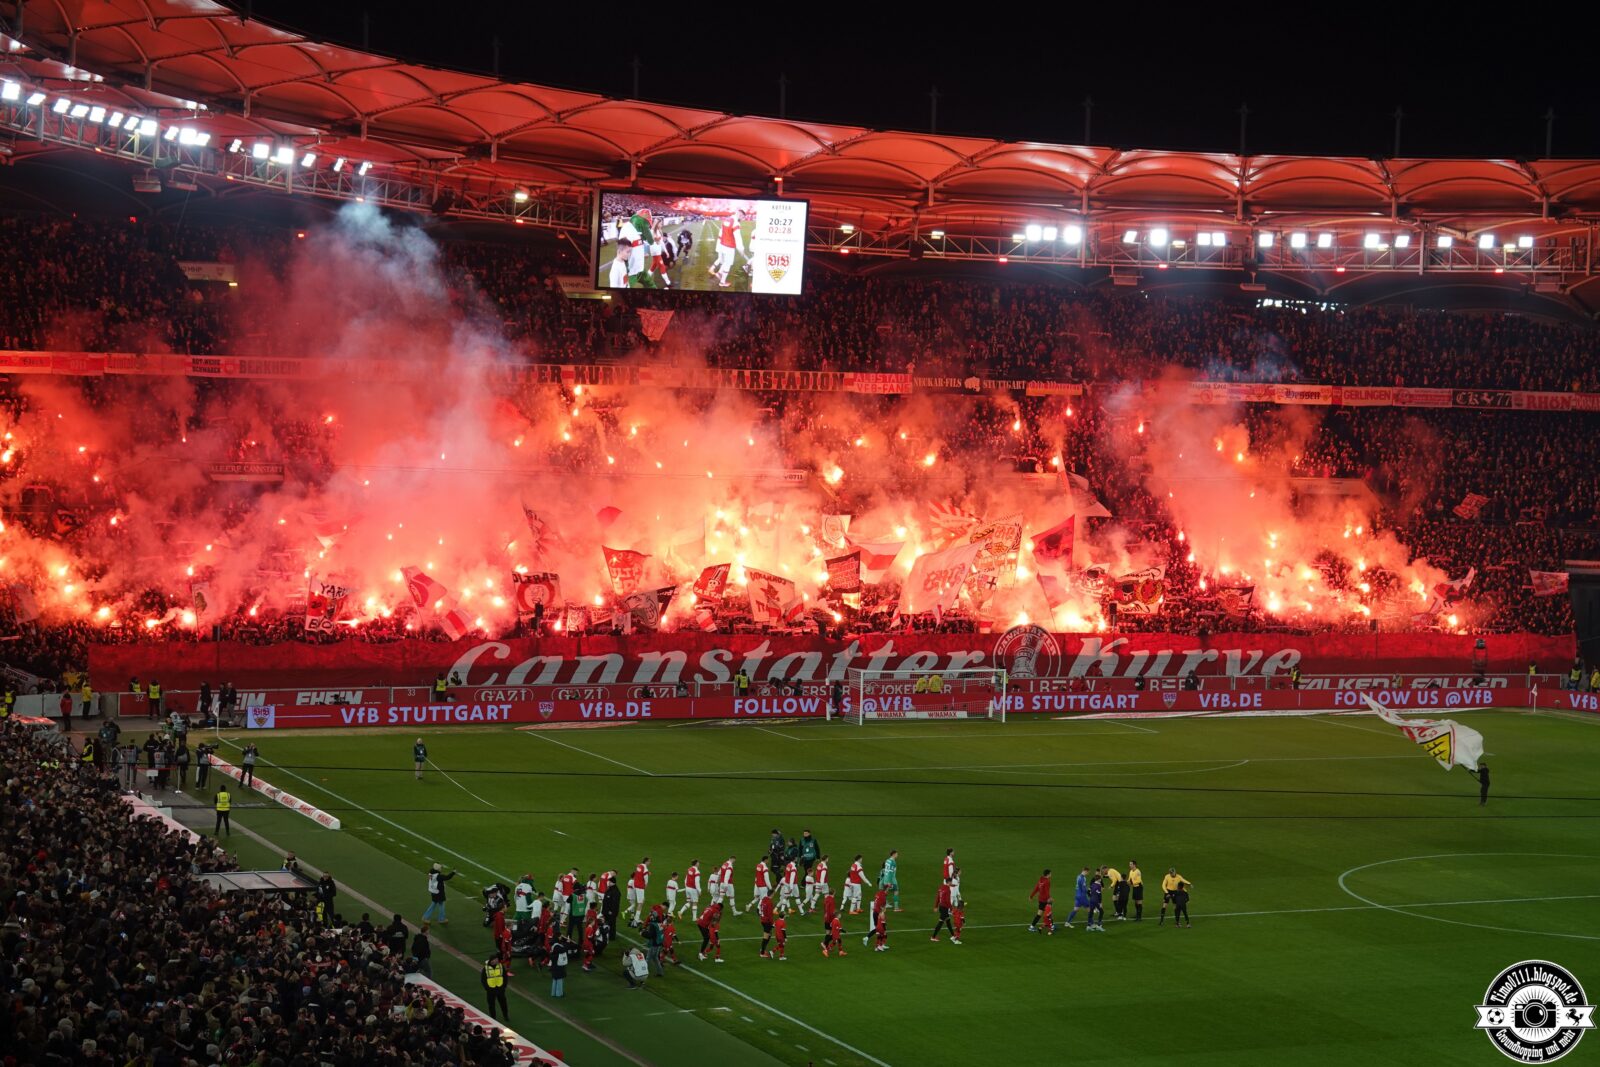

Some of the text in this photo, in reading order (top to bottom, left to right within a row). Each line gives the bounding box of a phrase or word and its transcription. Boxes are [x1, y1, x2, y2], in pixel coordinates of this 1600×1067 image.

[769, 217, 793, 226] 20:27
[768, 226, 792, 234] 02:28
[1343, 390, 1391, 401] GERLINGEN
[450, 636, 1301, 686] Cannstatter Kurve
[407, 688, 416, 697] 33
[1199, 692, 1263, 708] VfB.DE
[1417, 690, 1439, 705] US
[1445, 690, 1493, 706] @VfB
[579, 701, 652, 718] VfB.DE
[734, 697, 820, 714] FOLLOW
[863, 695, 913, 712] @VfB
[992, 694, 1140, 711] VfB STUTTGART
[1569, 693, 1599, 710] VfB
[340, 704, 512, 724] VfB STUTTGART
